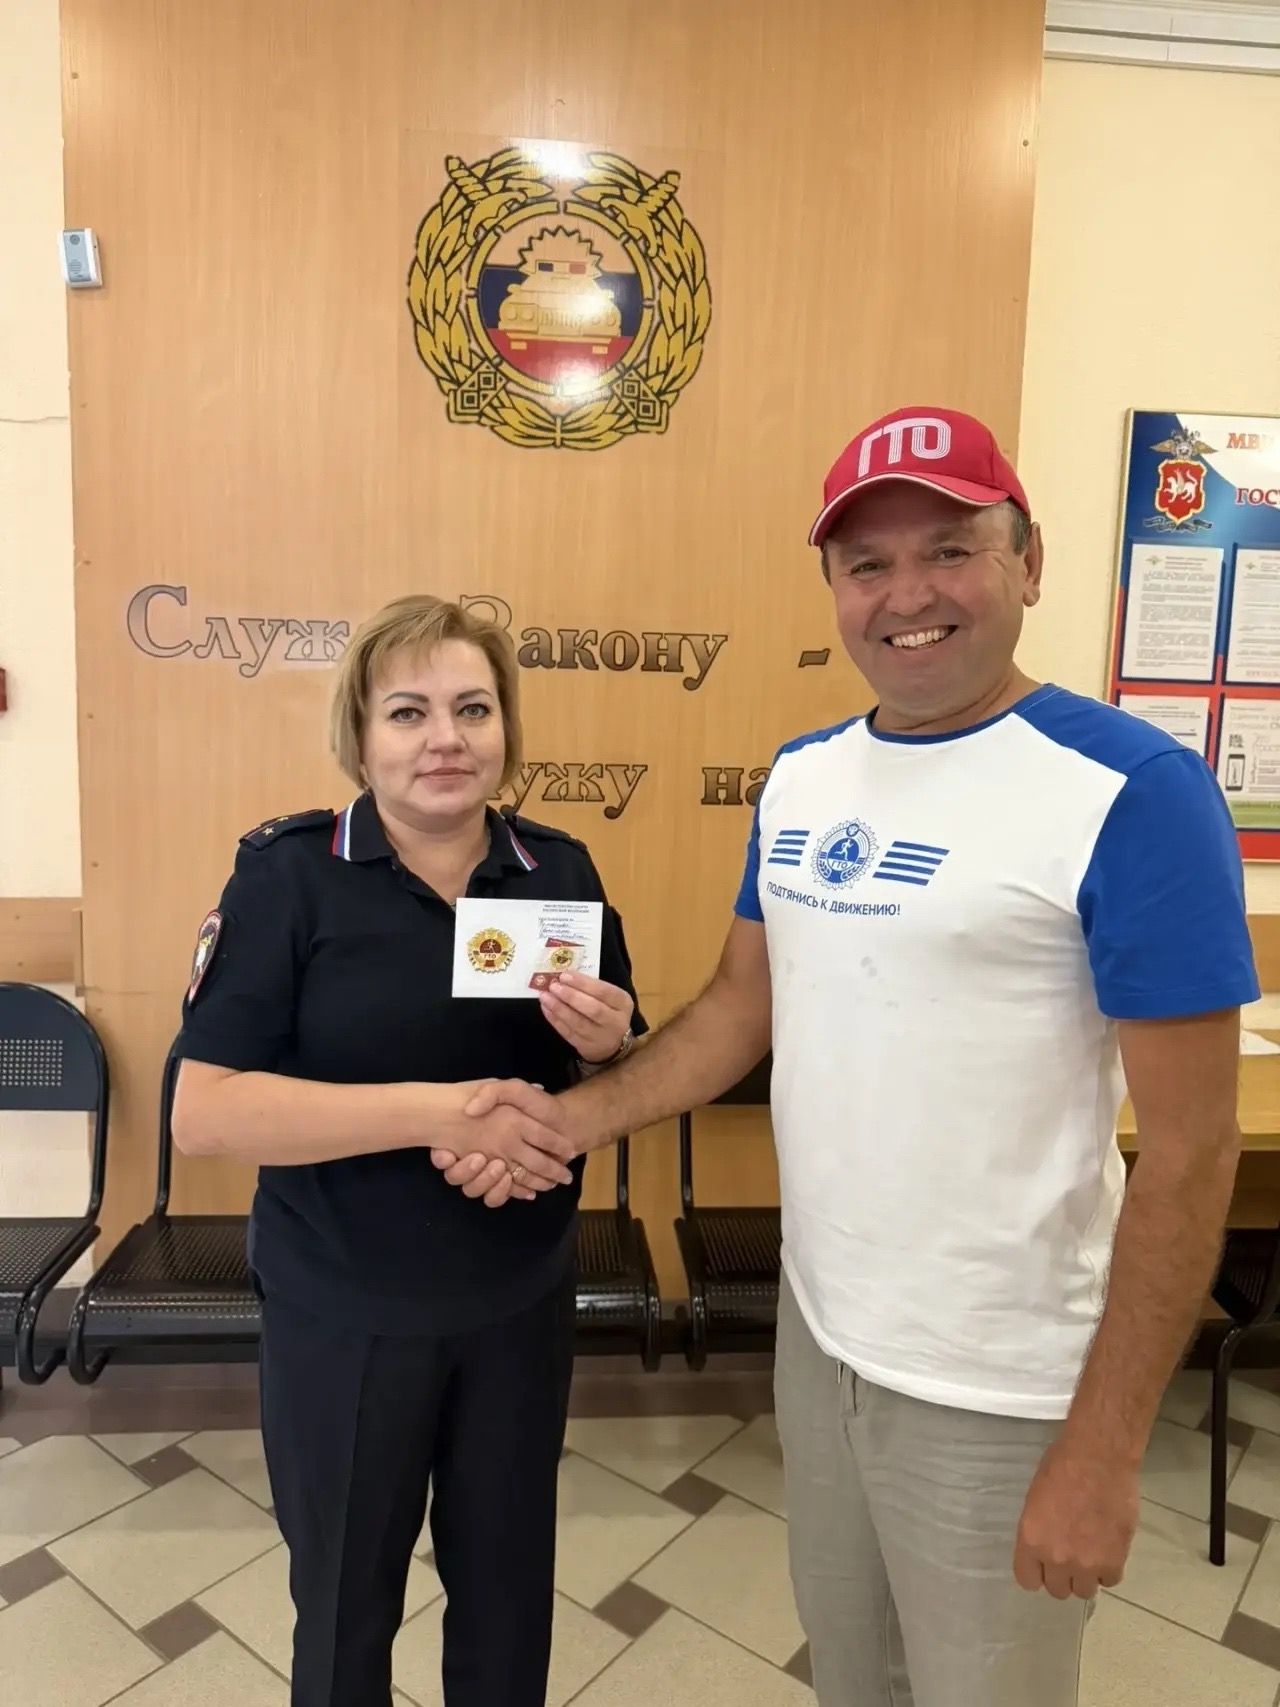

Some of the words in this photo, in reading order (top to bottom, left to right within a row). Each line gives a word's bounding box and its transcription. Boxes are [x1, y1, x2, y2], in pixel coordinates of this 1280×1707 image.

[858, 417, 951, 478] ГТО
[1227, 432, 1274, 450] МВ
[1236, 487, 1280, 505] ГОС
[127, 584, 350, 678] Служ
[488, 762, 648, 820] ужу
[831, 859, 849, 869] ГТО
[766, 881, 819, 908] ПОДТЯНИСЬ
[821, 898, 829, 910] К
[829, 900, 901, 916] ДВИЖЕНИЮ!
